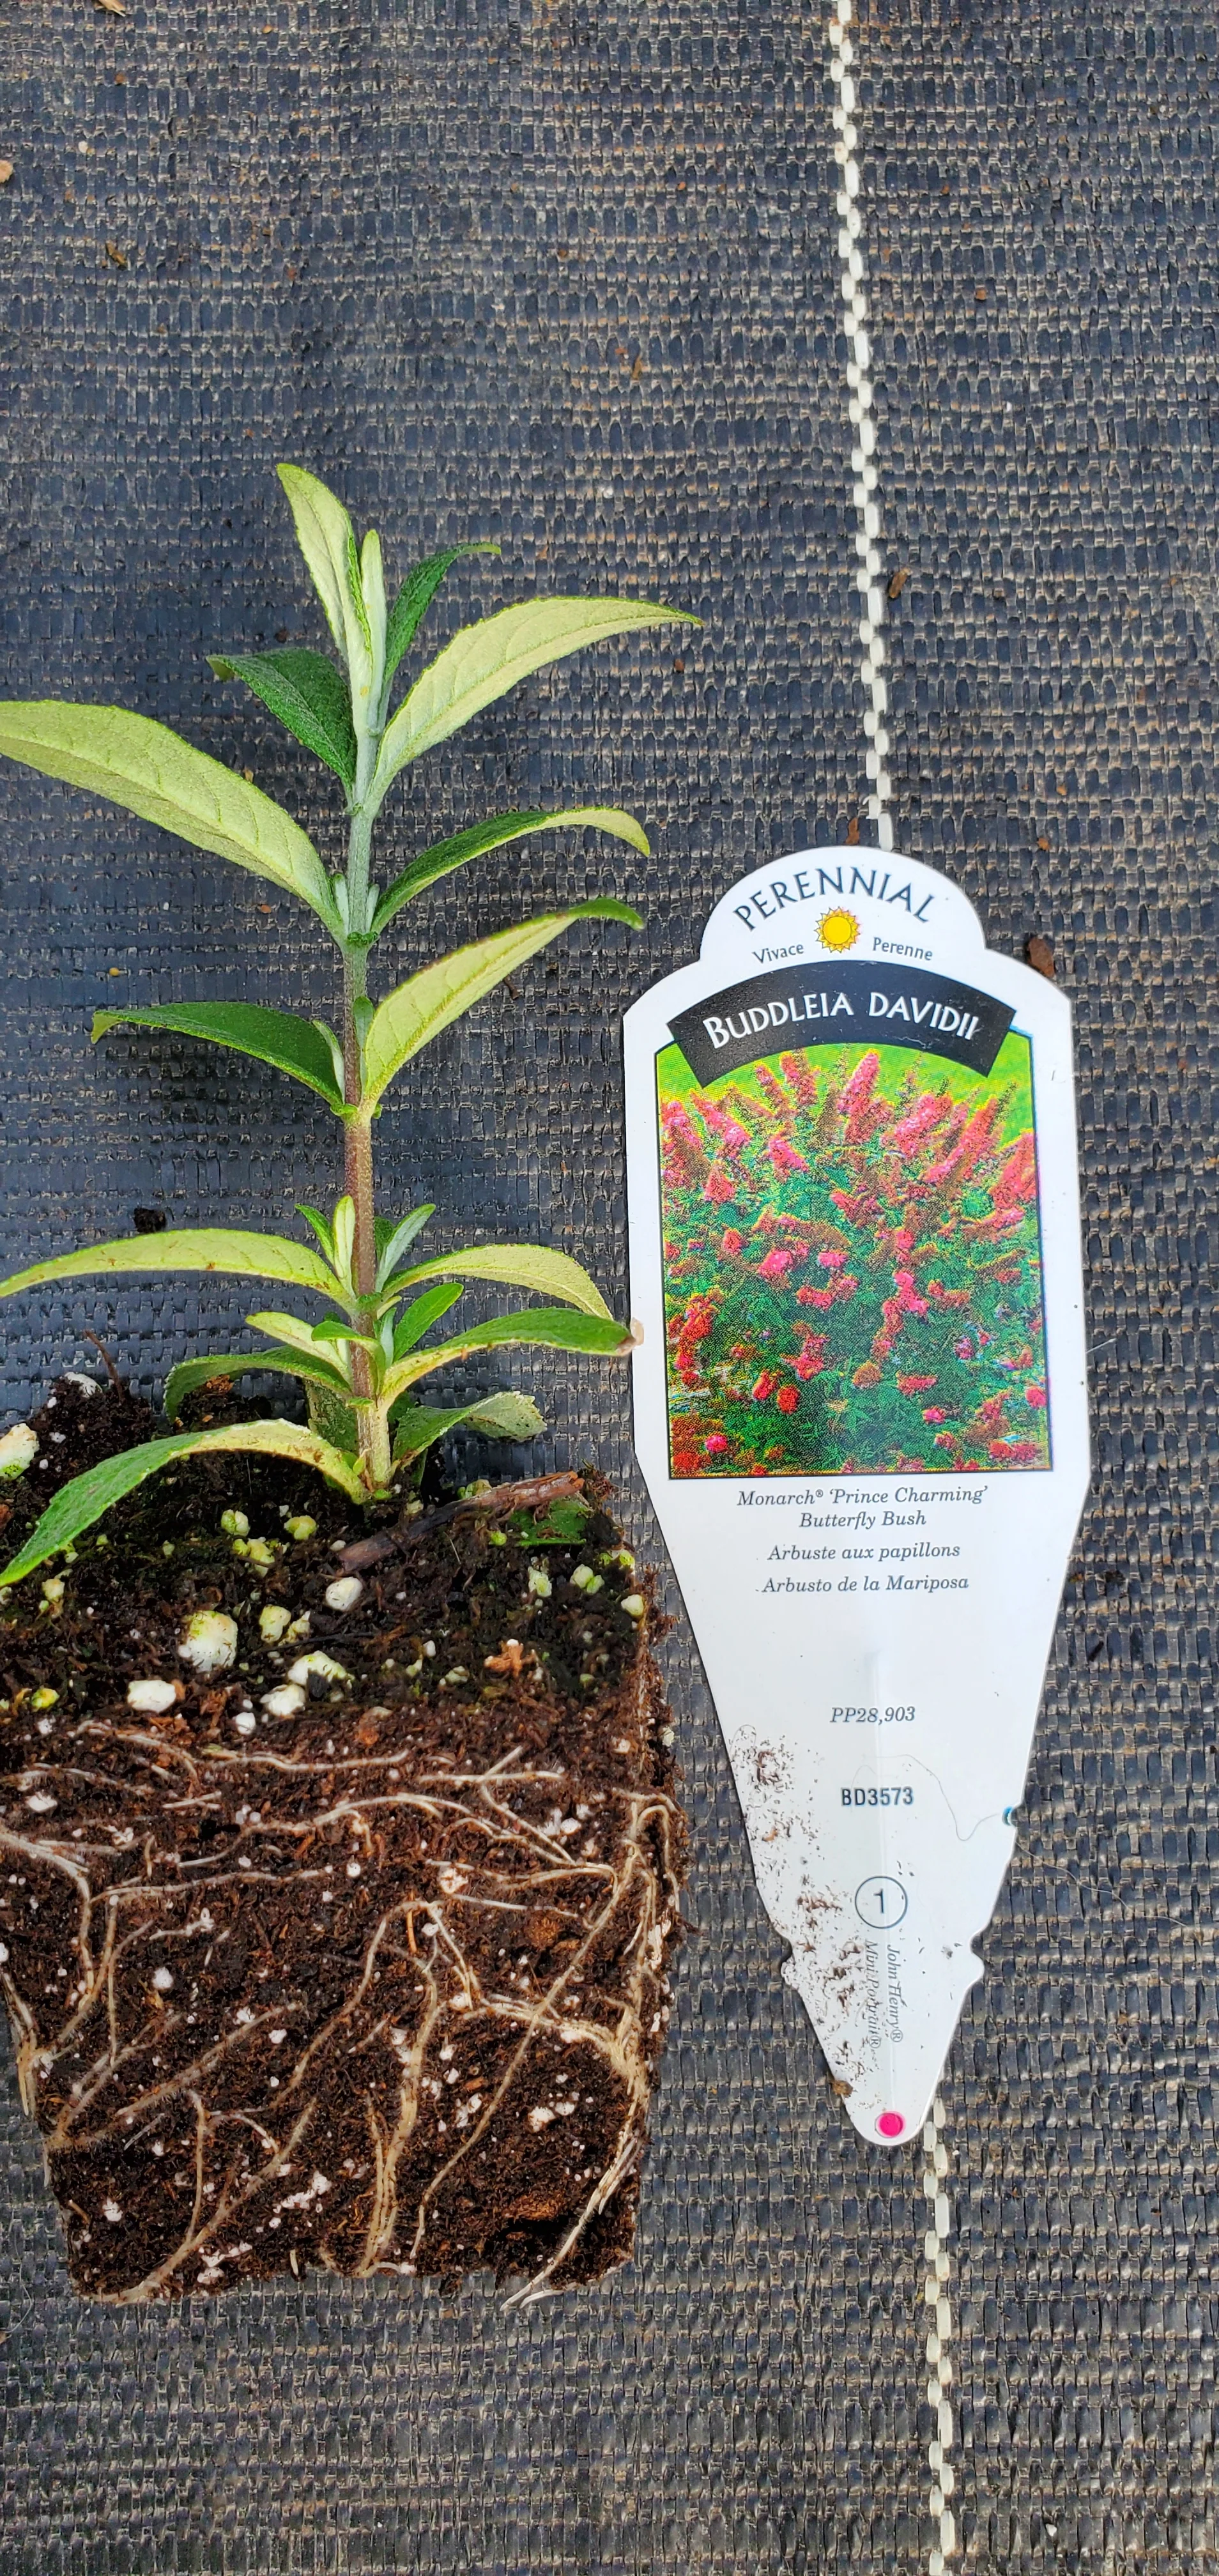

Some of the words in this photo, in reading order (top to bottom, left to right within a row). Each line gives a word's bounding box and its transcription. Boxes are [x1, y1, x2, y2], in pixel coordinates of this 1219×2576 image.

[732, 866, 937, 933] PERENNIAL
[752, 942, 805, 965] Vivace
[872, 937, 933, 962] Perenne
[702, 992, 854, 1050] BUDDLEIA
[868, 991, 980, 1041] DAVIDII
[798, 1511, 876, 1530] Butterfly
[881, 1510, 927, 1526] Bush
[767, 1545, 836, 1561] Arbuste
[841, 1548, 874, 1560] aux
[877, 1542, 960, 1562] papillons
[761, 1577, 832, 1593] Arbusto
[837, 1575, 857, 1592] de
[863, 1575, 880, 1591] la
[885, 1574, 969, 1593] Mariposa
[829, 1706, 916, 1726] PP28,903
[841, 1786, 914, 1806] BD3573
[873, 1888, 885, 1914] 1
[887, 1944, 901, 1979] John
